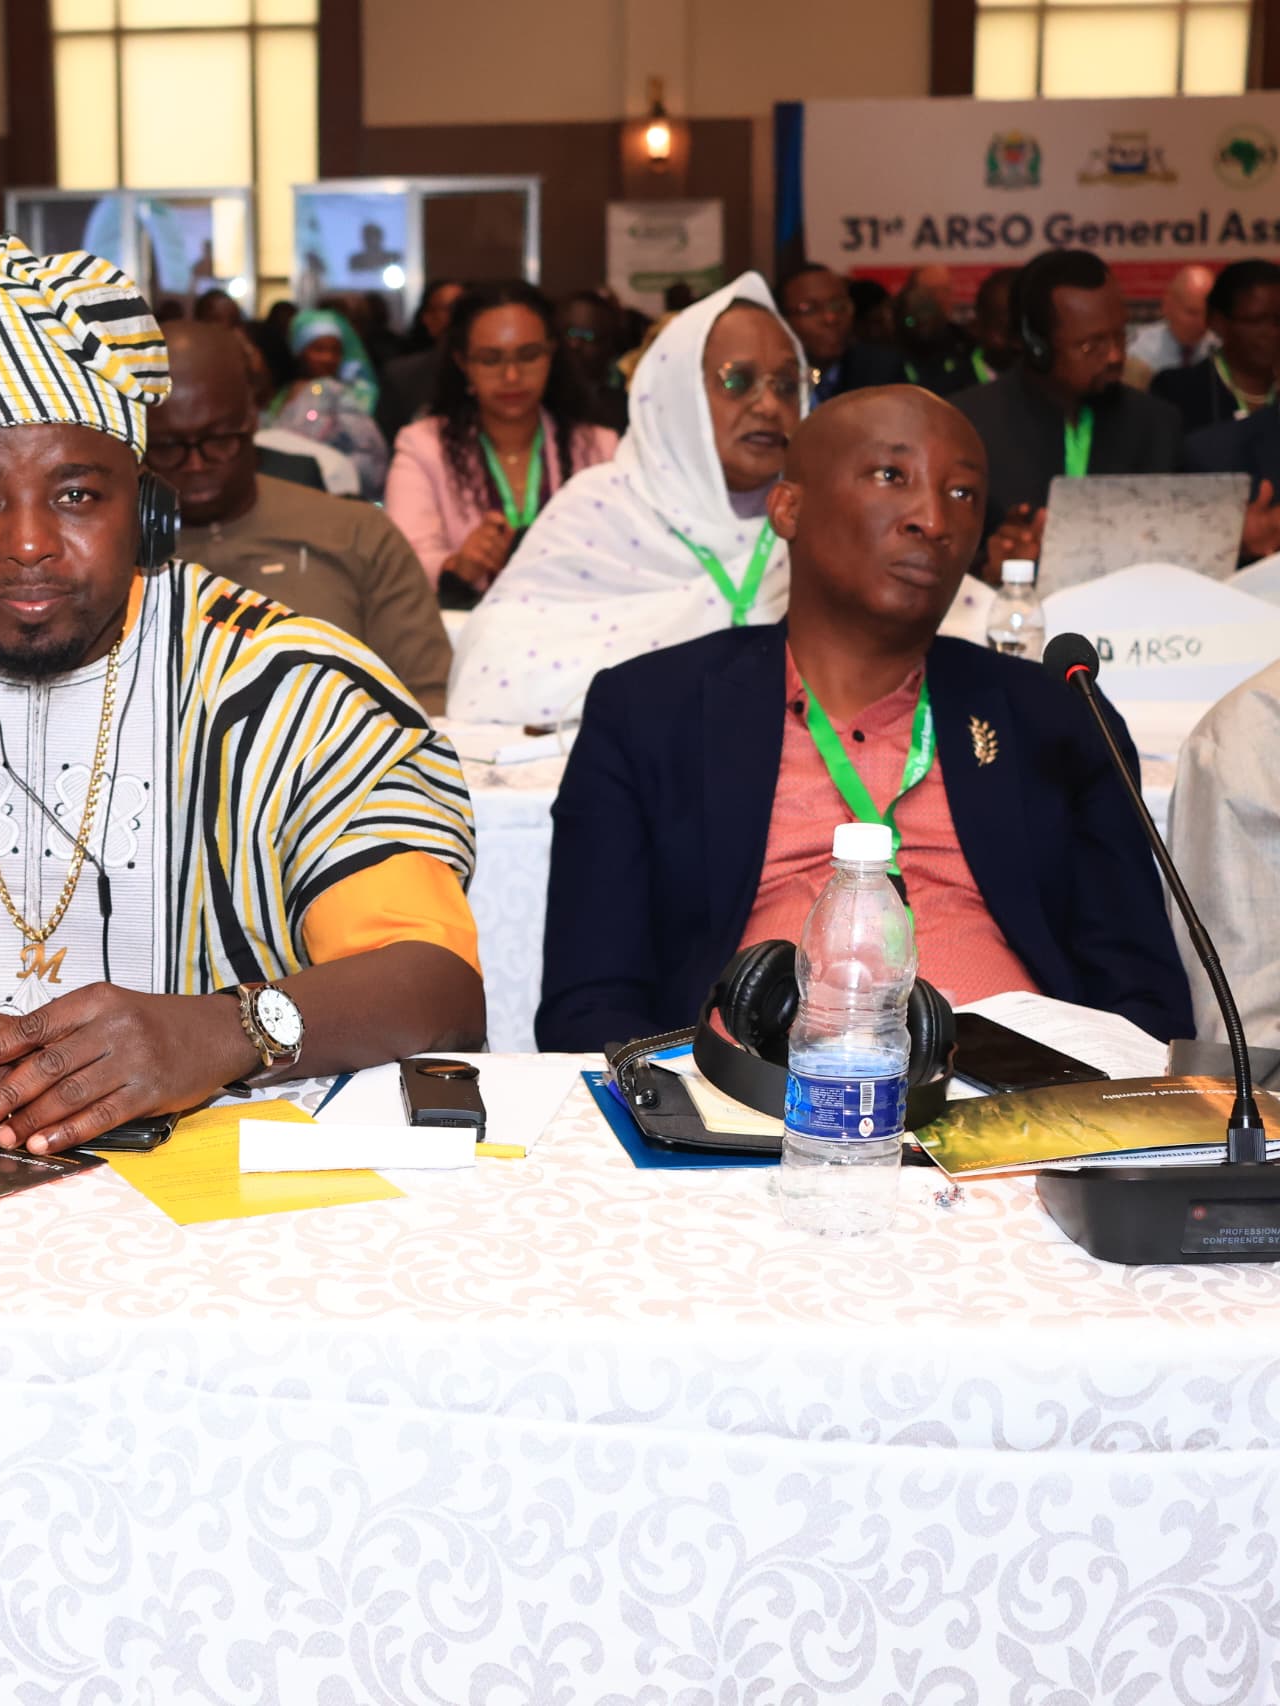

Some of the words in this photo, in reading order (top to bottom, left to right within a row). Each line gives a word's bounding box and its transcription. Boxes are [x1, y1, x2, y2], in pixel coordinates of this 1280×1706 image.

[841, 215, 904, 251] 31st
[913, 213, 1033, 249] ARSO
[1043, 209, 1209, 247] General
[1101, 1090, 1156, 1100] Assembly
[1202, 1236, 1265, 1245] CONFERENCE
